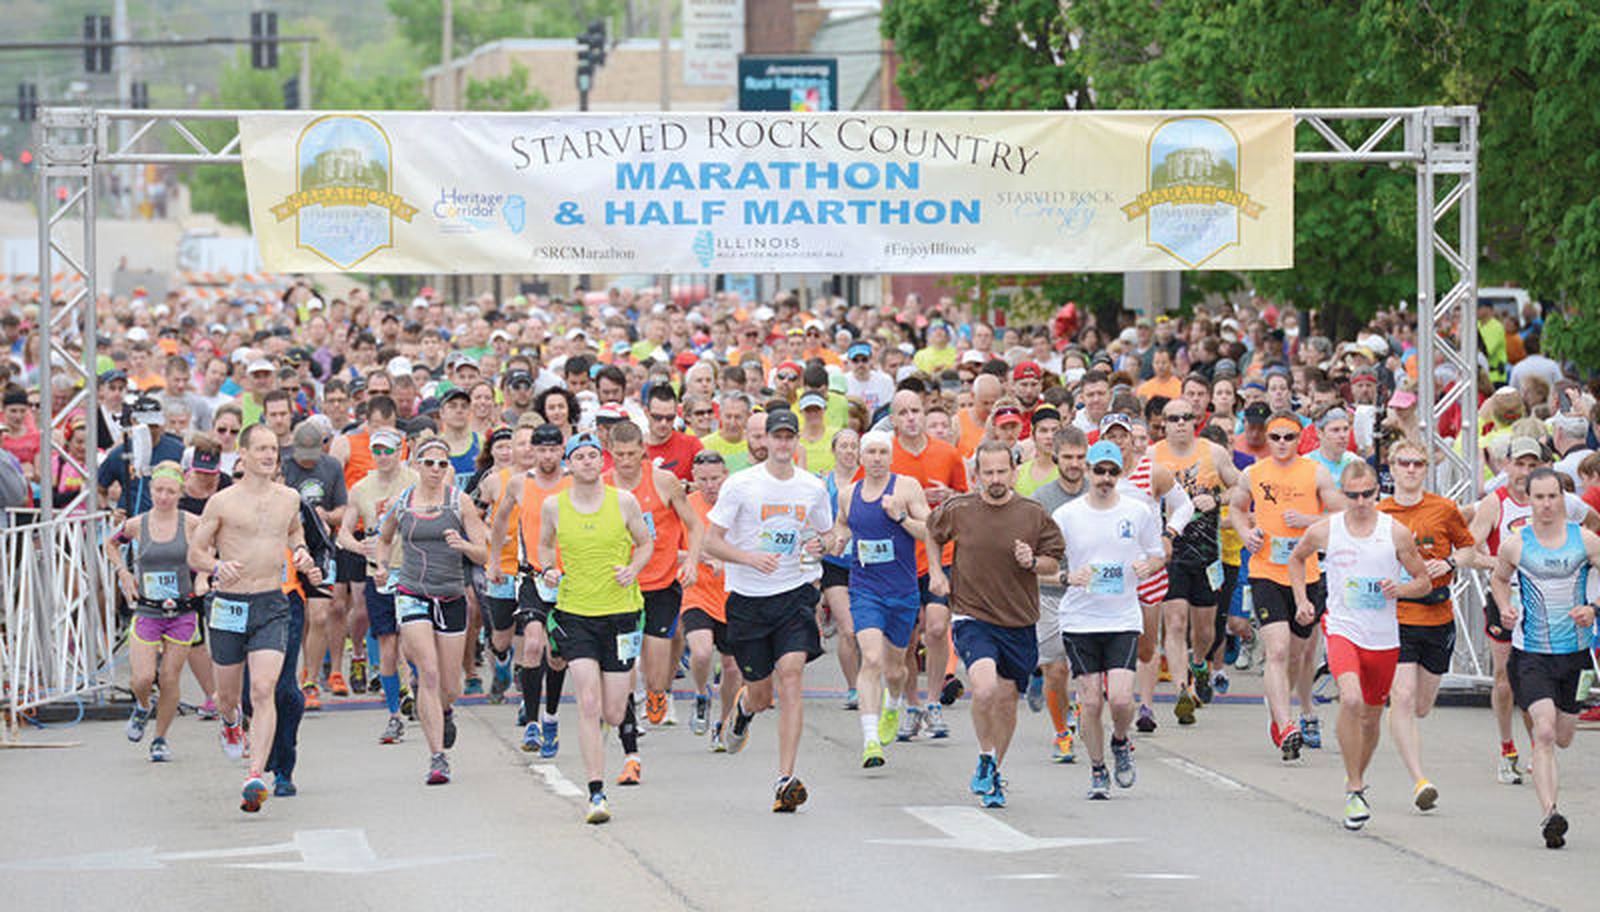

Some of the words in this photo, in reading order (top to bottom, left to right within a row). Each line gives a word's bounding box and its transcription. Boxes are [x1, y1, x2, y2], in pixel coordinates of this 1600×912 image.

[511, 121, 688, 171] STARVED
[708, 117, 823, 149] ROCK
[838, 118, 1039, 175] COUNTRY
[616, 161, 920, 191] MARATHON
[440, 188, 504, 207] Heritage
[554, 201, 585, 225] &
[605, 200, 726, 225] HALF
[744, 199, 981, 225] MARTHON
[717, 236, 800, 250] ILLINOIS
[884, 241, 978, 260] #EnjoyIllinois
[533, 245, 636, 261] #SRCMarathon
[230, 605, 244, 617] 10
